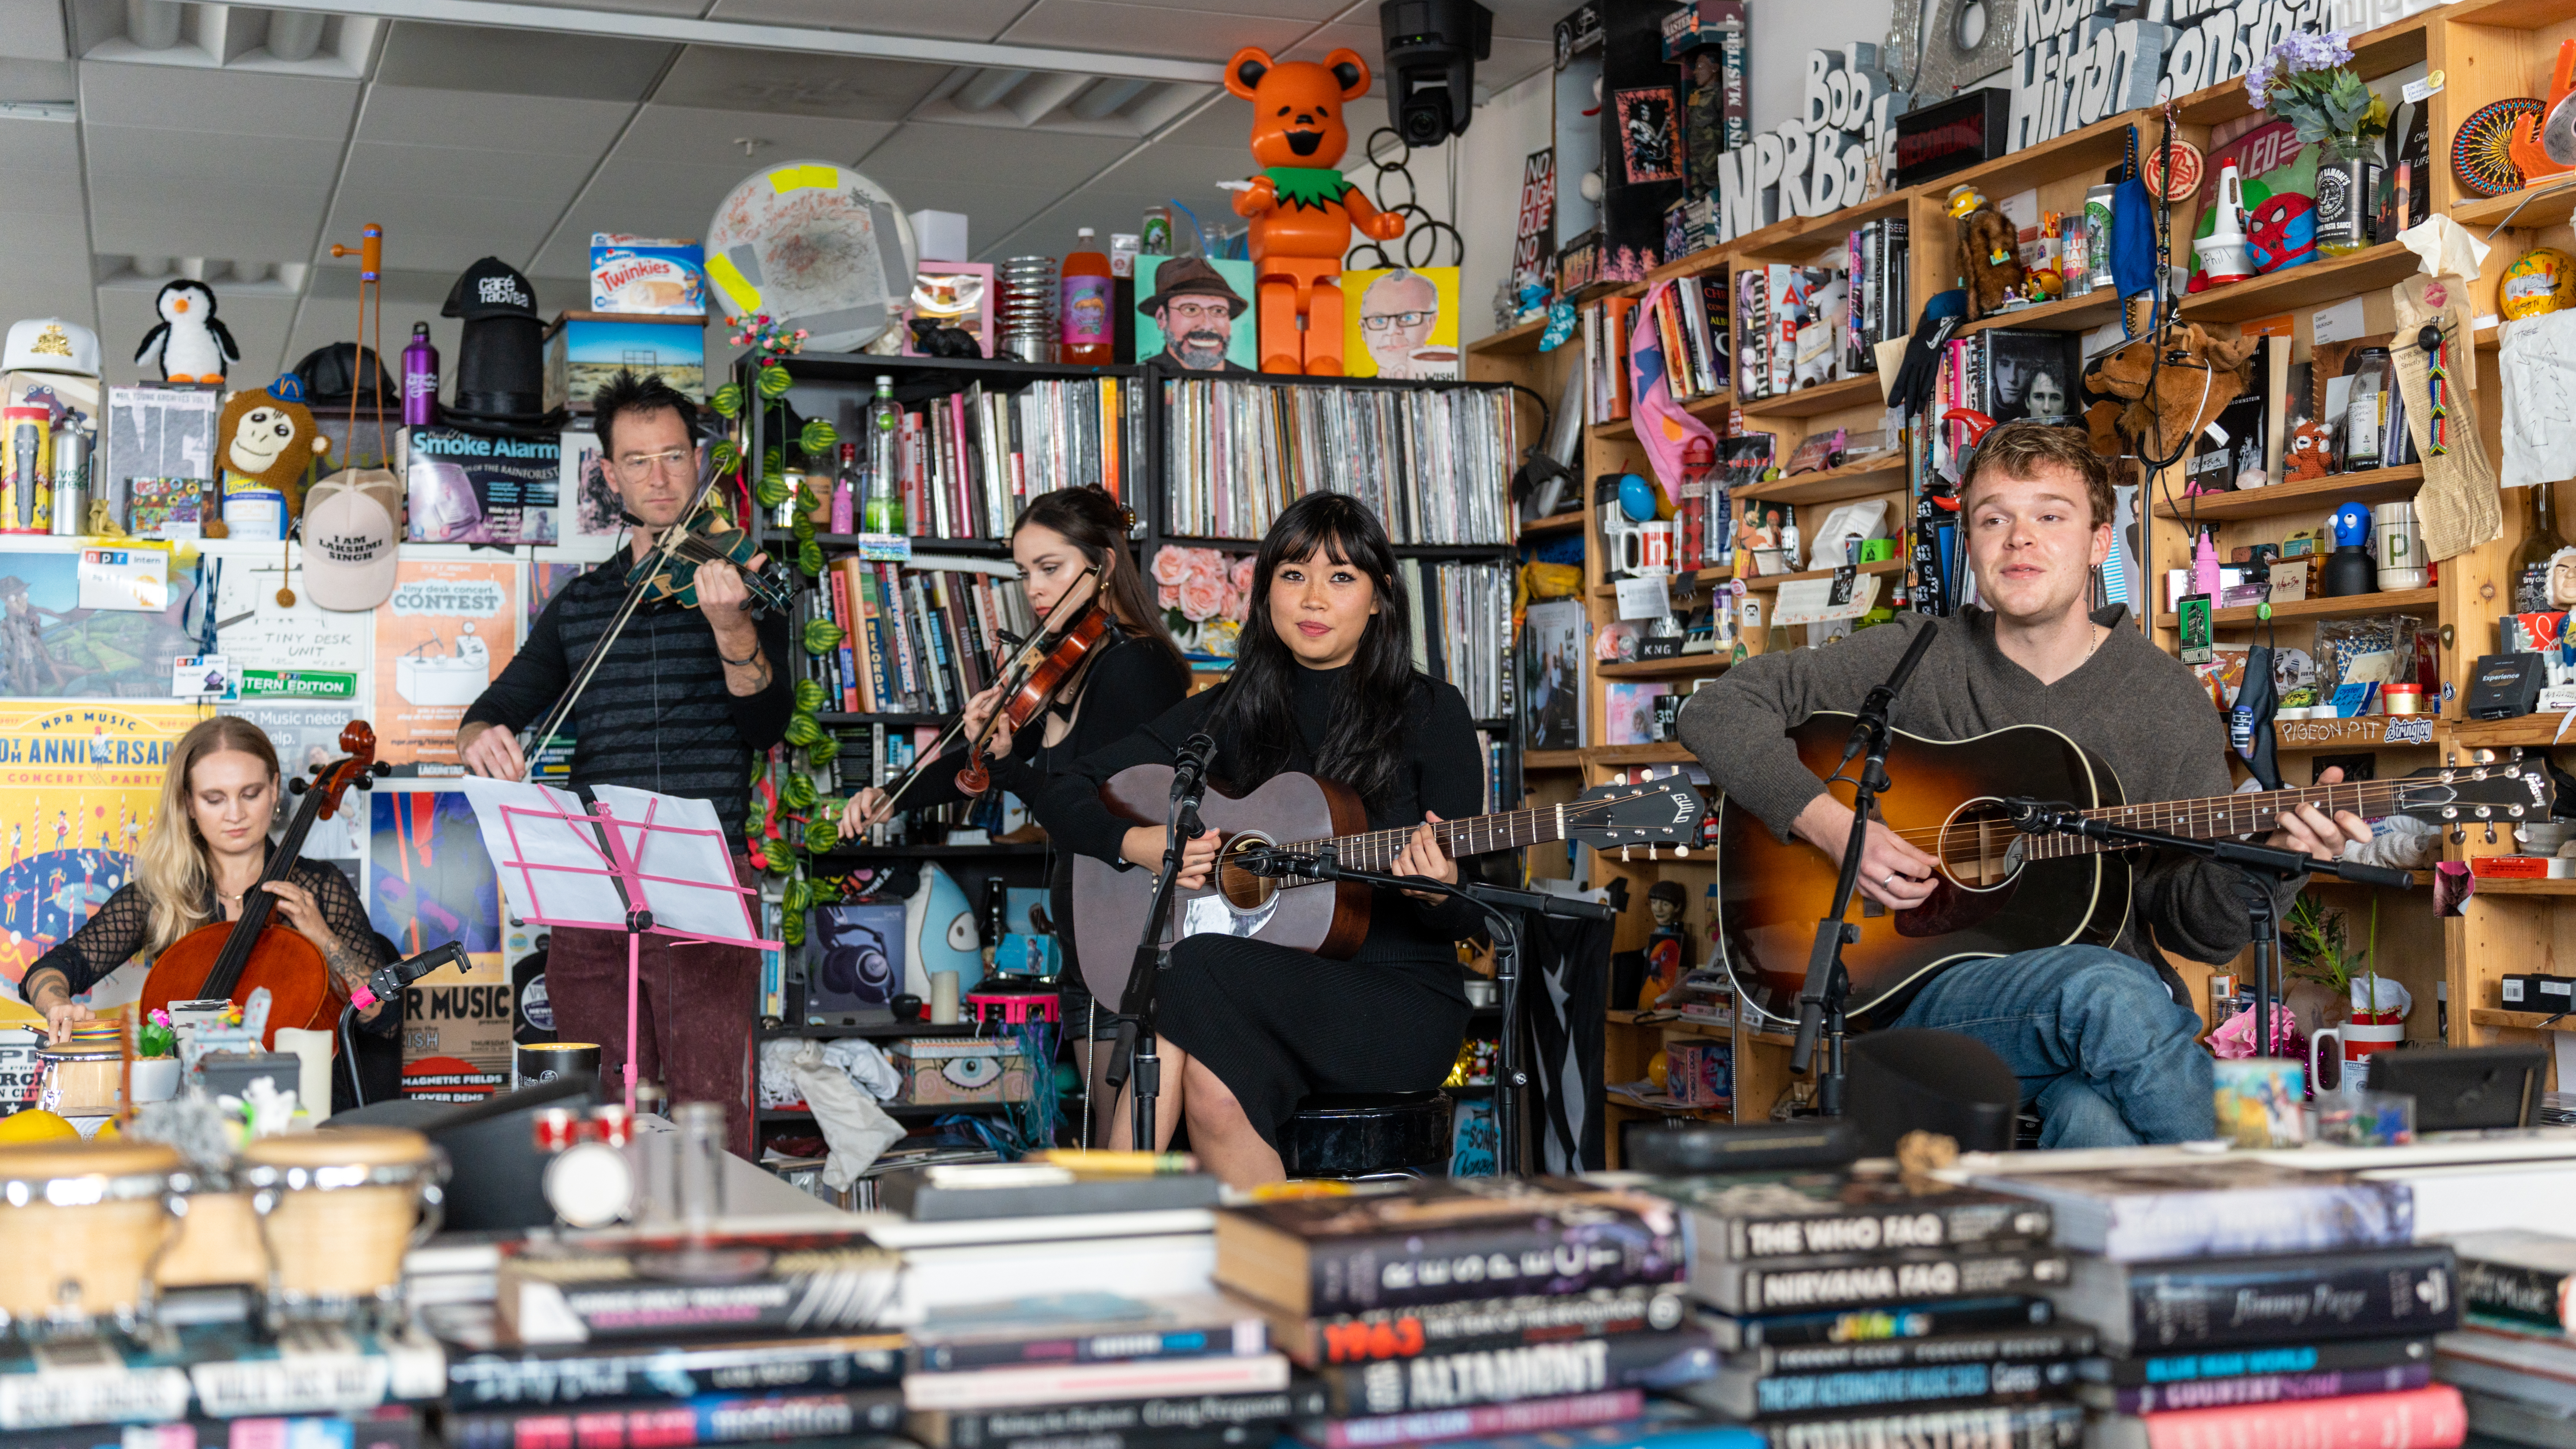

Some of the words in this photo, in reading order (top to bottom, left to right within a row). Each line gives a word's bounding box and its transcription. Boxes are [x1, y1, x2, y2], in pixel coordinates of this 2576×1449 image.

[1726, 14, 1736, 25] P
[1727, 31, 1743, 107] MASTER
[1804, 42, 1871, 133] Bob
[2006, 18, 2139, 155] Hilton
[1897, 113, 1983, 170] RECORDING
[1528, 153, 1551, 182] NO
[1717, 118, 1811, 244] NPR
[2323, 168, 2351, 186] RAMONE'S
[1524, 179, 1554, 210] DIGA
[1520, 210, 1549, 238] QUE
[1516, 237, 1539, 265] NO
[2062, 238, 2088, 250] BLUE
[2062, 249, 2090, 262] MAN
[597, 260, 671, 293] Twinkies
[2315, 314, 2326, 323] David
[2514, 327, 2539, 340] TREE
[2398, 351, 2412, 361] NPR
[2401, 358, 2420, 370] Strictly
[1425, 372, 1455, 381] WISH
[412, 432, 489, 457] Smoke
[494, 440, 559, 459] Alarm
[1729, 458, 1768, 467] YESSIE
[484, 464, 499, 473] THE
[500, 466, 559, 481] RAINFOREST
[318, 538, 383, 552] LAKSHMI
[334, 536, 340, 544] I
[343, 535, 367, 544] AM
[133, 556, 161, 565] Intern
[328, 550, 373, 562] SINGH
[402, 585, 422, 595] tiny
[425, 585, 449, 594] desk
[452, 585, 493, 594] concert
[395, 594, 499, 610] CONTEST
[264, 632, 304, 644] TINY
[314, 632, 351, 645] DESK
[288, 646, 324, 658] UNIT
[866, 621, 885, 694] RECORDS
[2182, 648, 2211, 662] PRODUCTION
[2483, 672, 2520, 681] Experience
[287, 679, 346, 693] EDITION
[2339, 686, 2361, 695] oyster
[41, 713, 74, 731] NPR
[84, 712, 137, 731] MUSIC
[260, 710, 301, 726] Music
[305, 710, 348, 726] needs
[2282, 722, 2341, 743] PIGEON
[2347, 722, 2380, 739] PIT
[2386, 718, 2432, 743] Stringjoy
[8, 772, 84, 783] CONCERT
[111, 773, 162, 784] PARTY
[2525, 772, 2547, 808] Gibson
[1670, 793, 1696, 824] GUILD
[434, 987, 510, 1020] MUSIC
[402, 1075, 459, 1085] MAGNETIC
[462, 1074, 502, 1084] FIELDS
[411, 1093, 450, 1102] LOWER
[1747, 1222, 1801, 1255] THE
[1806, 1216, 1881, 1252] WHO
[1883, 1212, 1944, 1247] FAQ
[1763, 1268, 1895, 1307] NIRVANA
[1897, 1261, 1959, 1298] FAQ
[2231, 1289, 2309, 1325] Jimmy
[2311, 1282, 2367, 1320] Page
[1409, 1340, 1609, 1409] ALTAMONT
